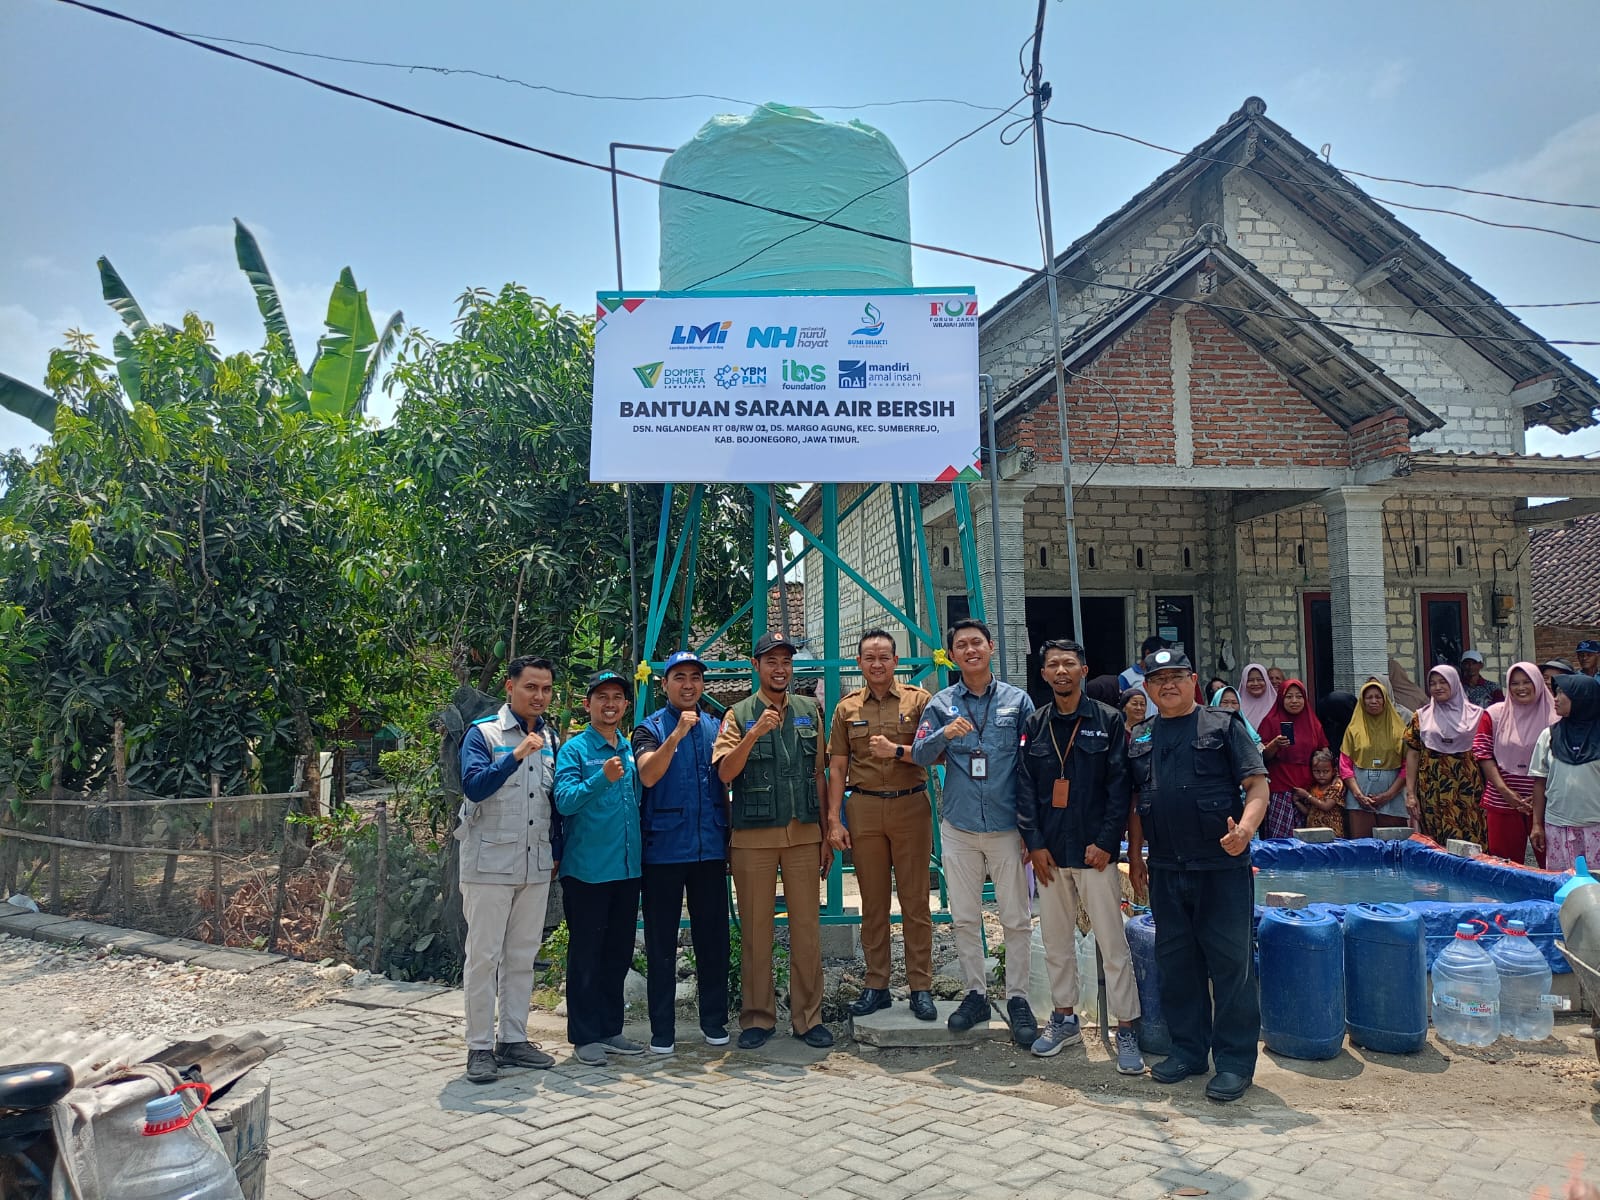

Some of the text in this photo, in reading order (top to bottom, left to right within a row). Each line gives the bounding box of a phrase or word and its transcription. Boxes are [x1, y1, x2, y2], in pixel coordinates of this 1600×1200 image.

[746, 326, 797, 348] NH
[799, 329, 827, 339] nurul
[797, 338, 829, 349] hayat
[740, 366, 767, 376] YBM
[782, 359, 826, 382] ibs
[868, 362, 909, 372] mandiri
[664, 368, 706, 377] DOMPET
[868, 372, 921, 381] amal insani
[664, 377, 706, 385] DHUAFA
[742, 376, 767, 385] PLN
[782, 382, 826, 391] foundation
[619, 400, 955, 418] BANTUAN SARANA AIR BERSIH
[632, 425, 654, 433] DSN.
[656, 424, 710, 433] NGLANDEAN
[712, 424, 723, 432] RT
[725, 424, 754, 433] 08/RW
[770, 424, 785, 432] DS.
[786, 424, 819, 432] MARGO
[820, 424, 855, 433] AGUNG,
[857, 424, 877, 432] KEC.
[878, 424, 940, 433] SUMBERREJO,
[736, 436, 801, 445] BOJONEGORO,
[828, 435, 860, 443] TIMUR.
